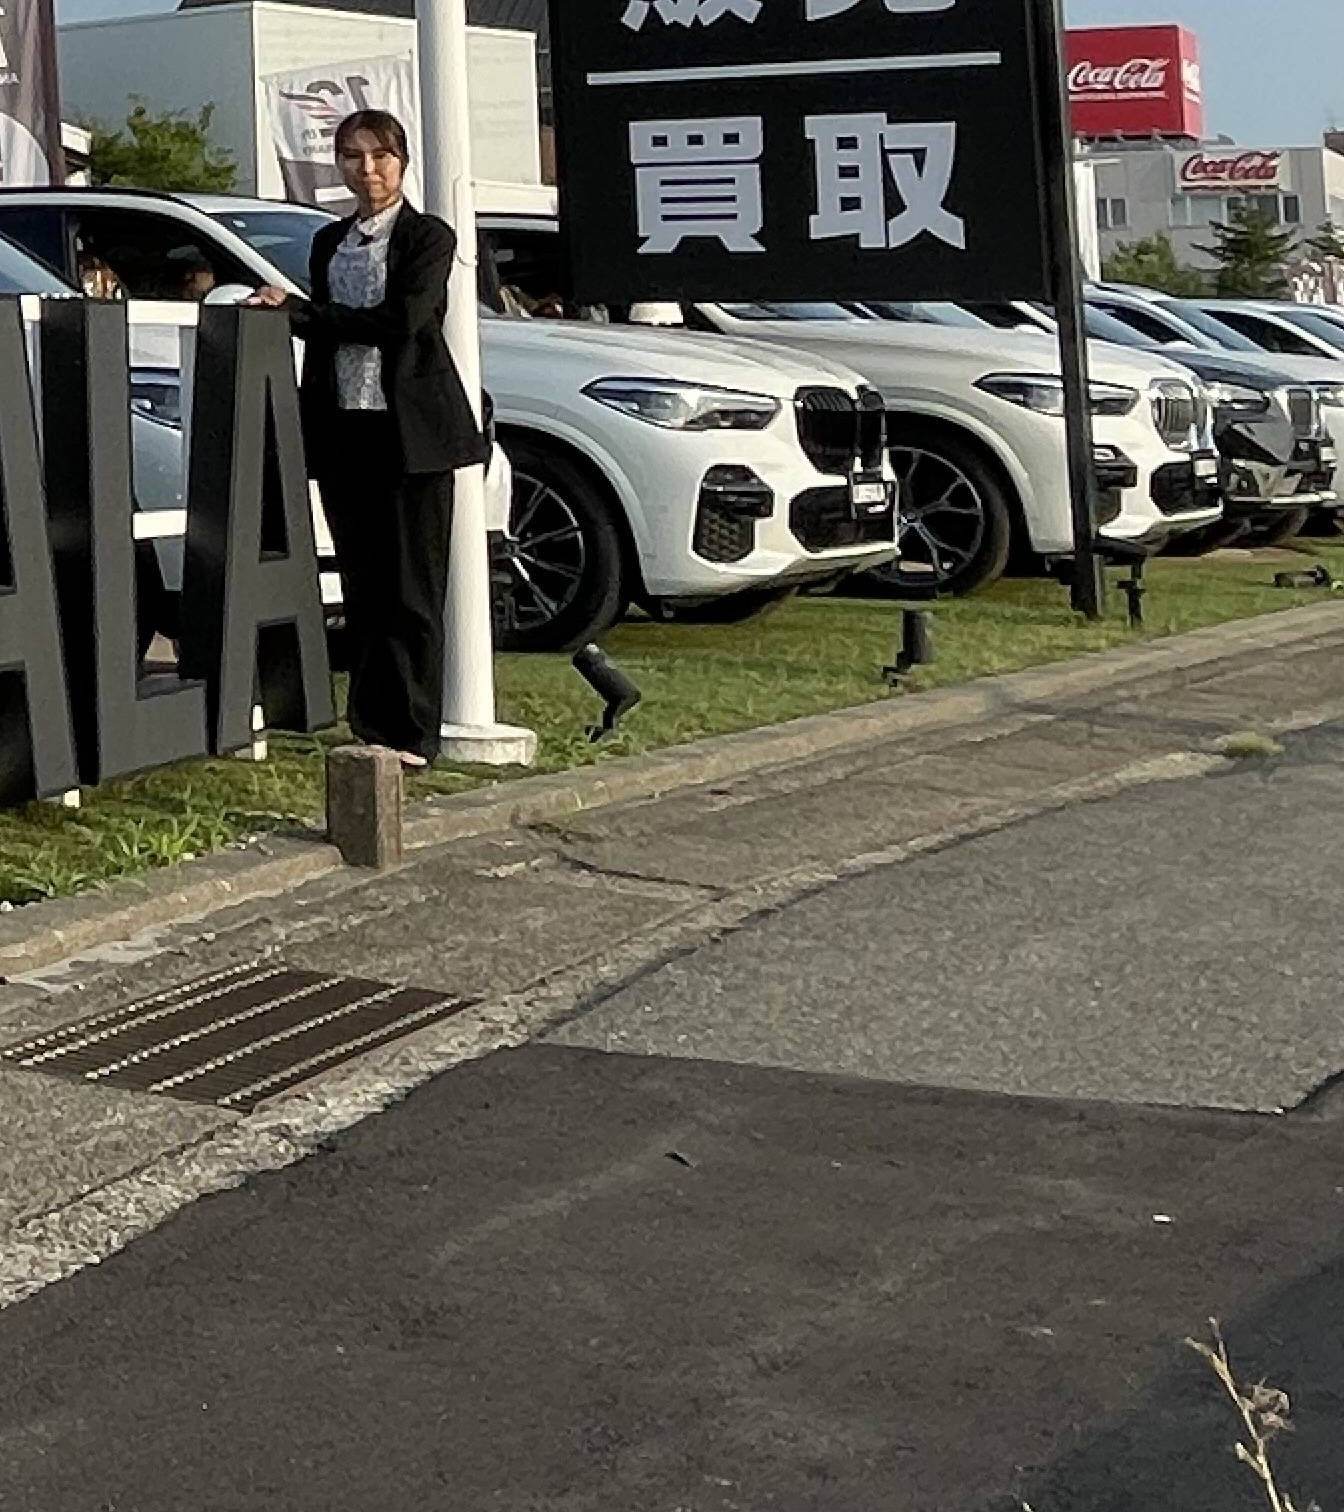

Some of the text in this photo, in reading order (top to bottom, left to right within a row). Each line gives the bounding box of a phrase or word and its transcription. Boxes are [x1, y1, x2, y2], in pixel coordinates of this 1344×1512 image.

[1067, 58, 1171, 91] Coca-Cola
[628, 112, 966, 254] 買取
[1180, 150, 1281, 183] Coca-Cola
